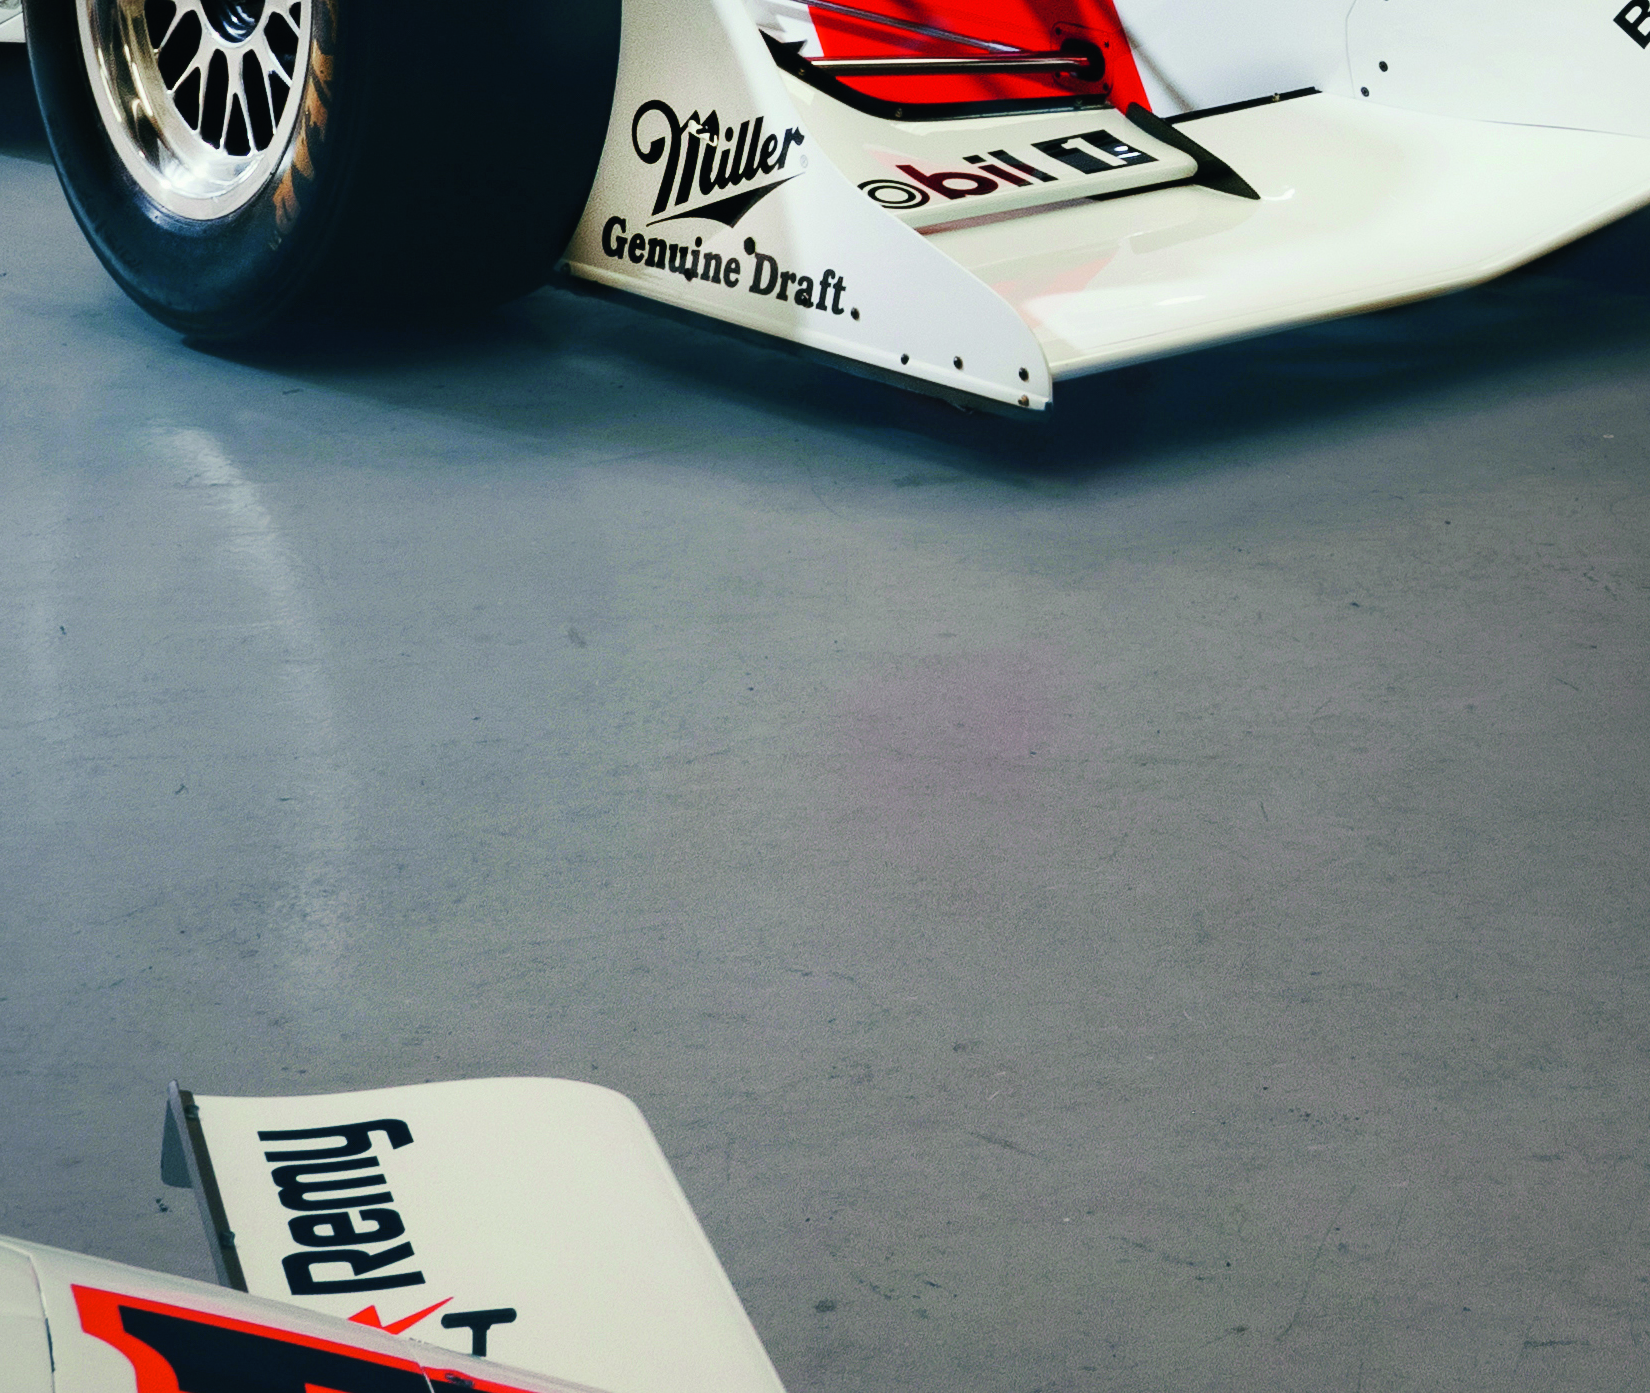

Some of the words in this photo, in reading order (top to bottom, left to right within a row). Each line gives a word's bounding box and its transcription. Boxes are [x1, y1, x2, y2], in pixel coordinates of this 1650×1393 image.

[632, 99, 805, 216] Miller
[857, 149, 1058, 209] obil
[601, 215, 740, 289] Genuine
[257, 1117, 426, 1296] Remy
